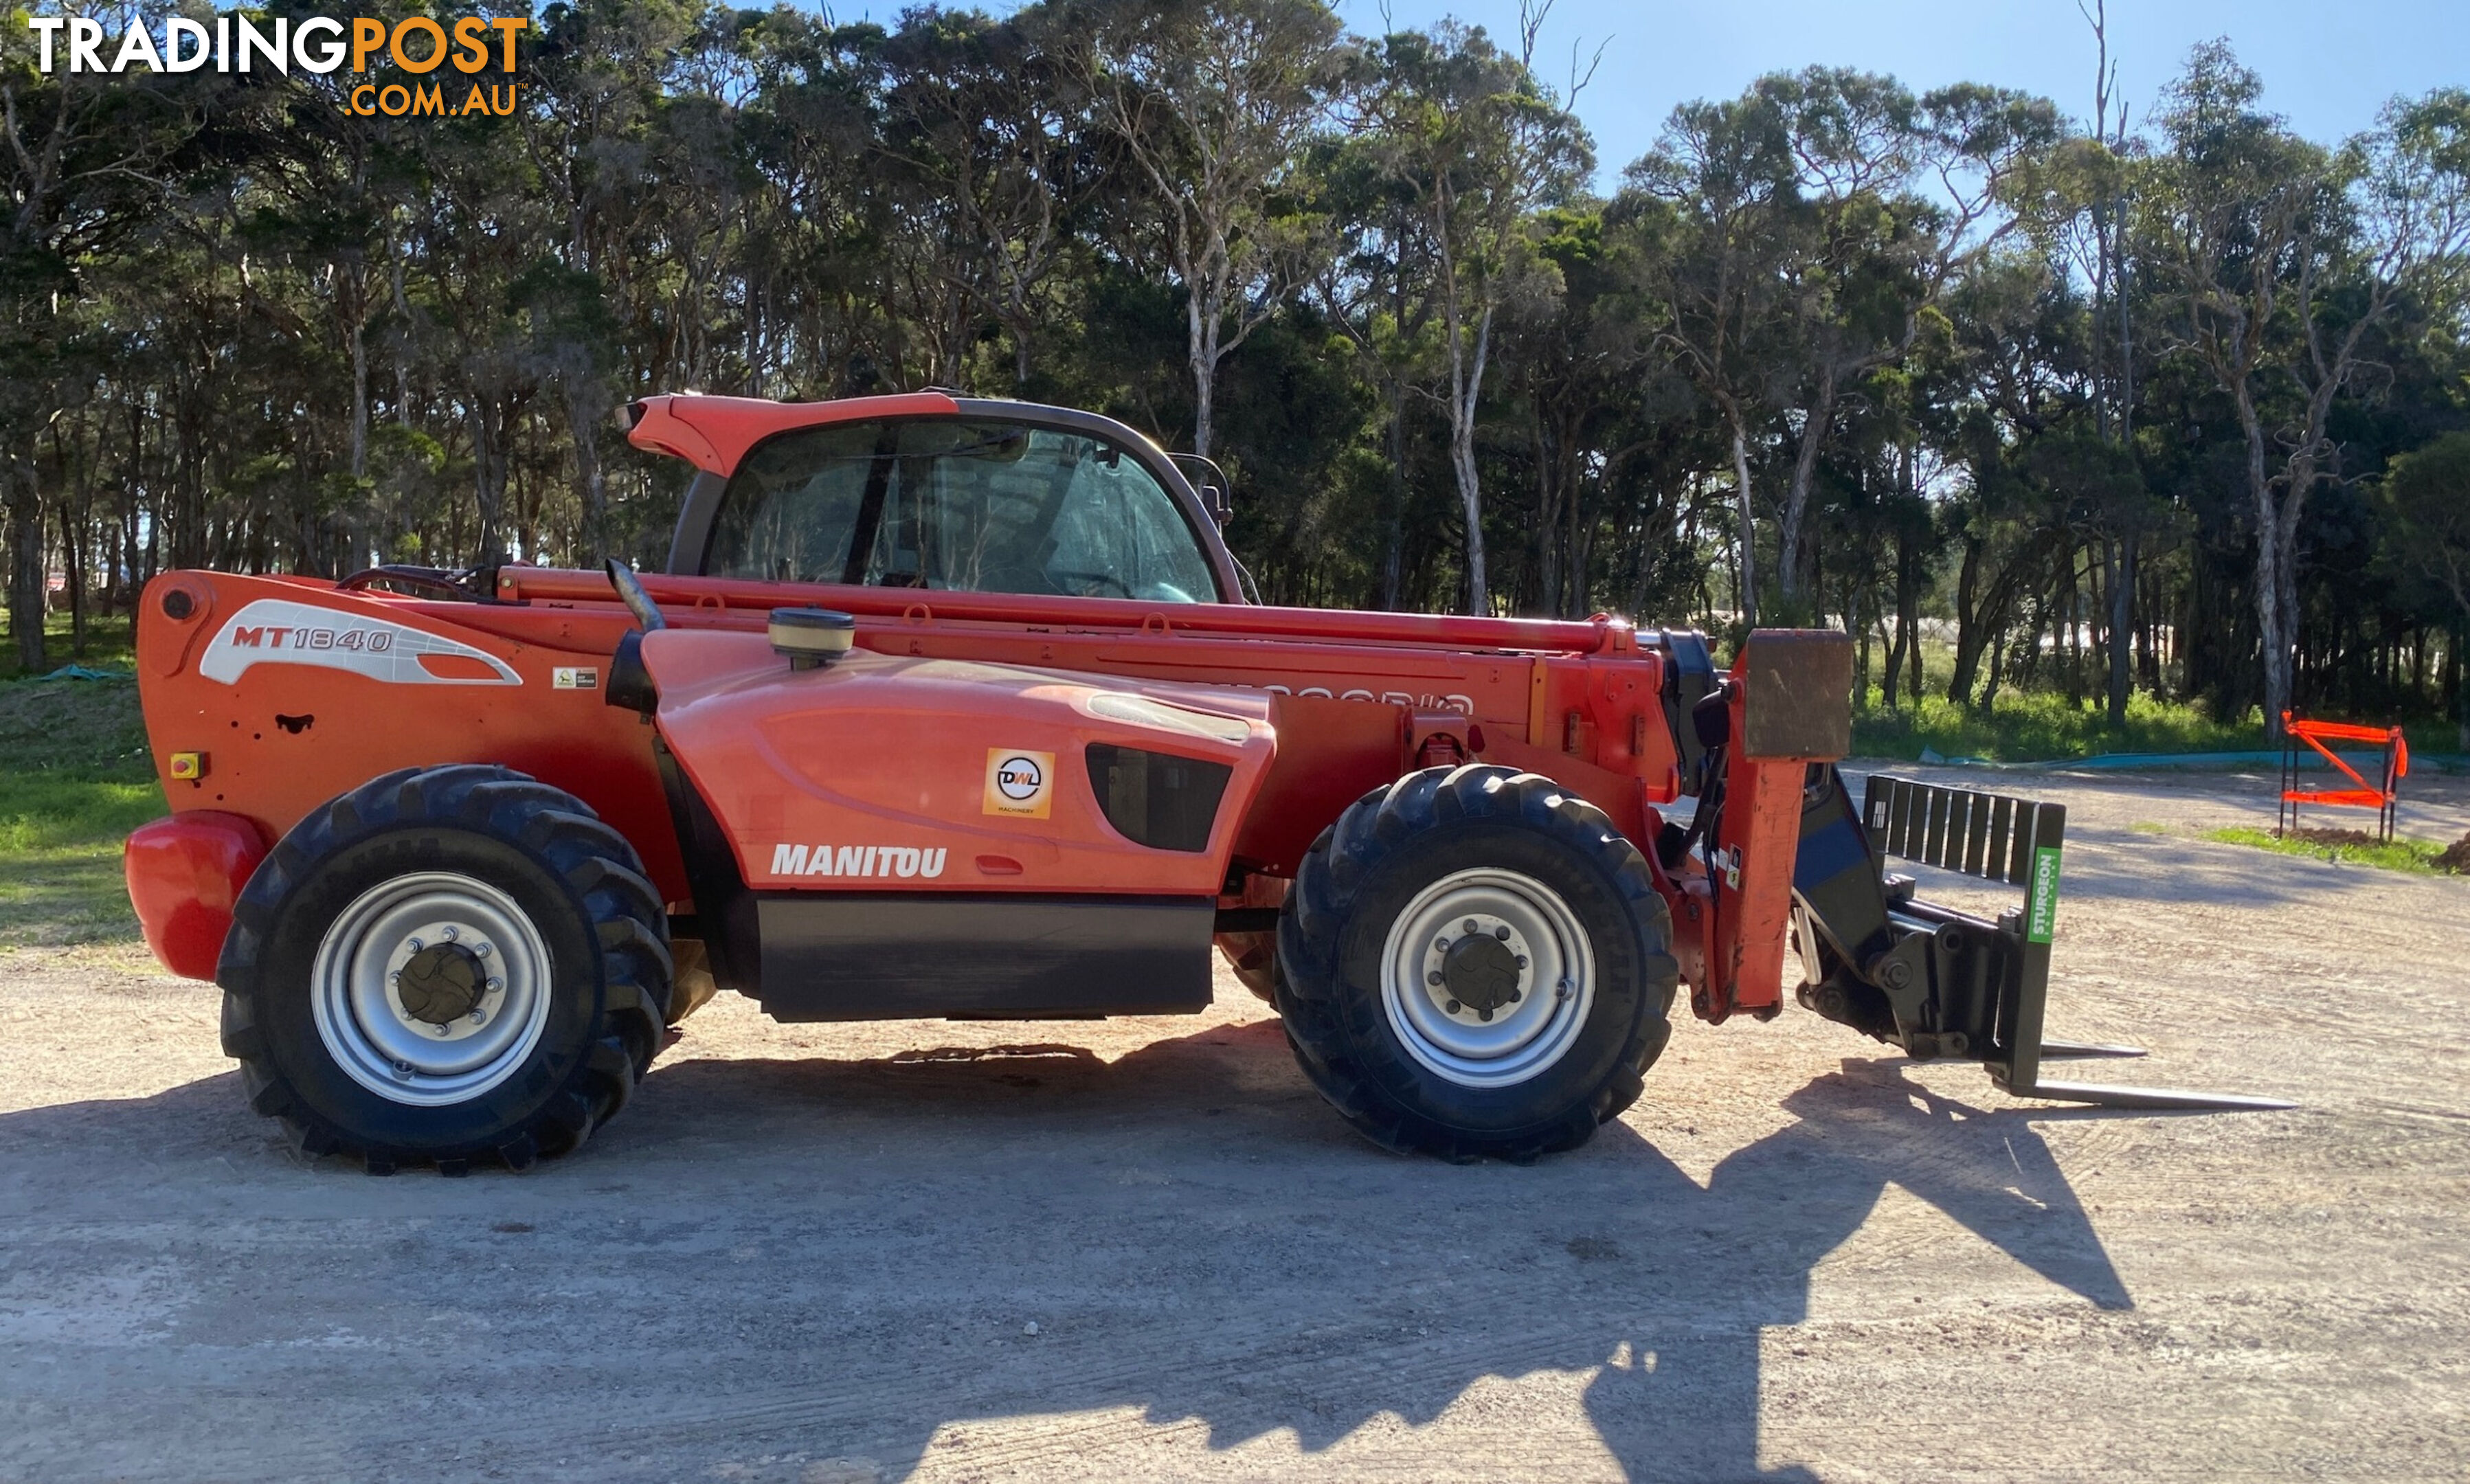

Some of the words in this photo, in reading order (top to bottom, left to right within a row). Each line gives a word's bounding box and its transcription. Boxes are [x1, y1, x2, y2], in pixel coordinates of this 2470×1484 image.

[232, 626, 392, 652] MT1840
[998, 771, 1041, 786] DWL
[770, 844, 947, 878] MANITOU
[2033, 854, 2052, 934] STURGEON
